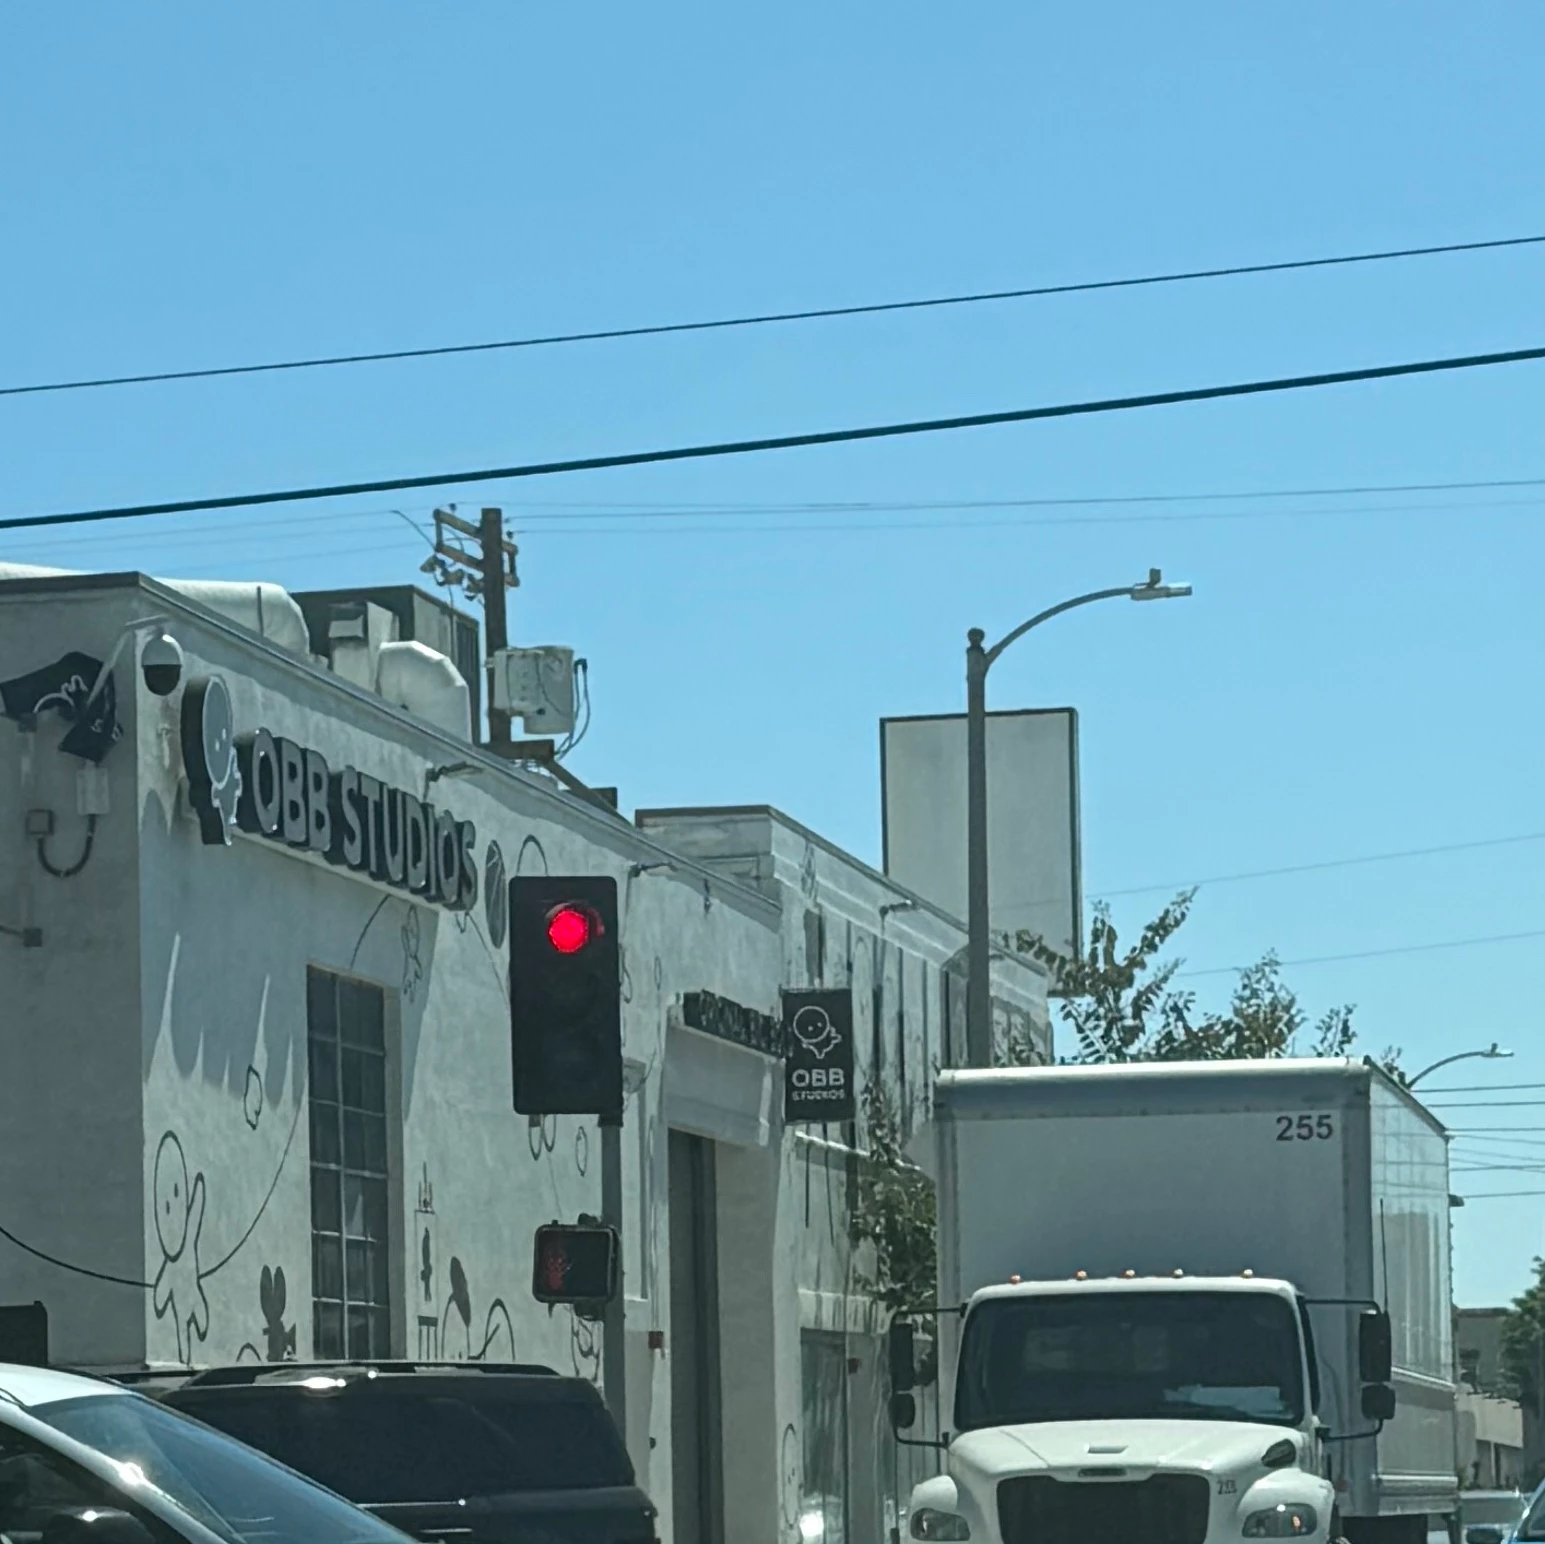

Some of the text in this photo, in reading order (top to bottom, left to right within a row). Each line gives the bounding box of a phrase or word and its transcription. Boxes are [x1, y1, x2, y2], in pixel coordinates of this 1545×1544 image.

[252, 726, 479, 911] OBB STUDIOS
[791, 1067, 845, 1088] OBB
[1275, 1114, 1334, 1141] 255
